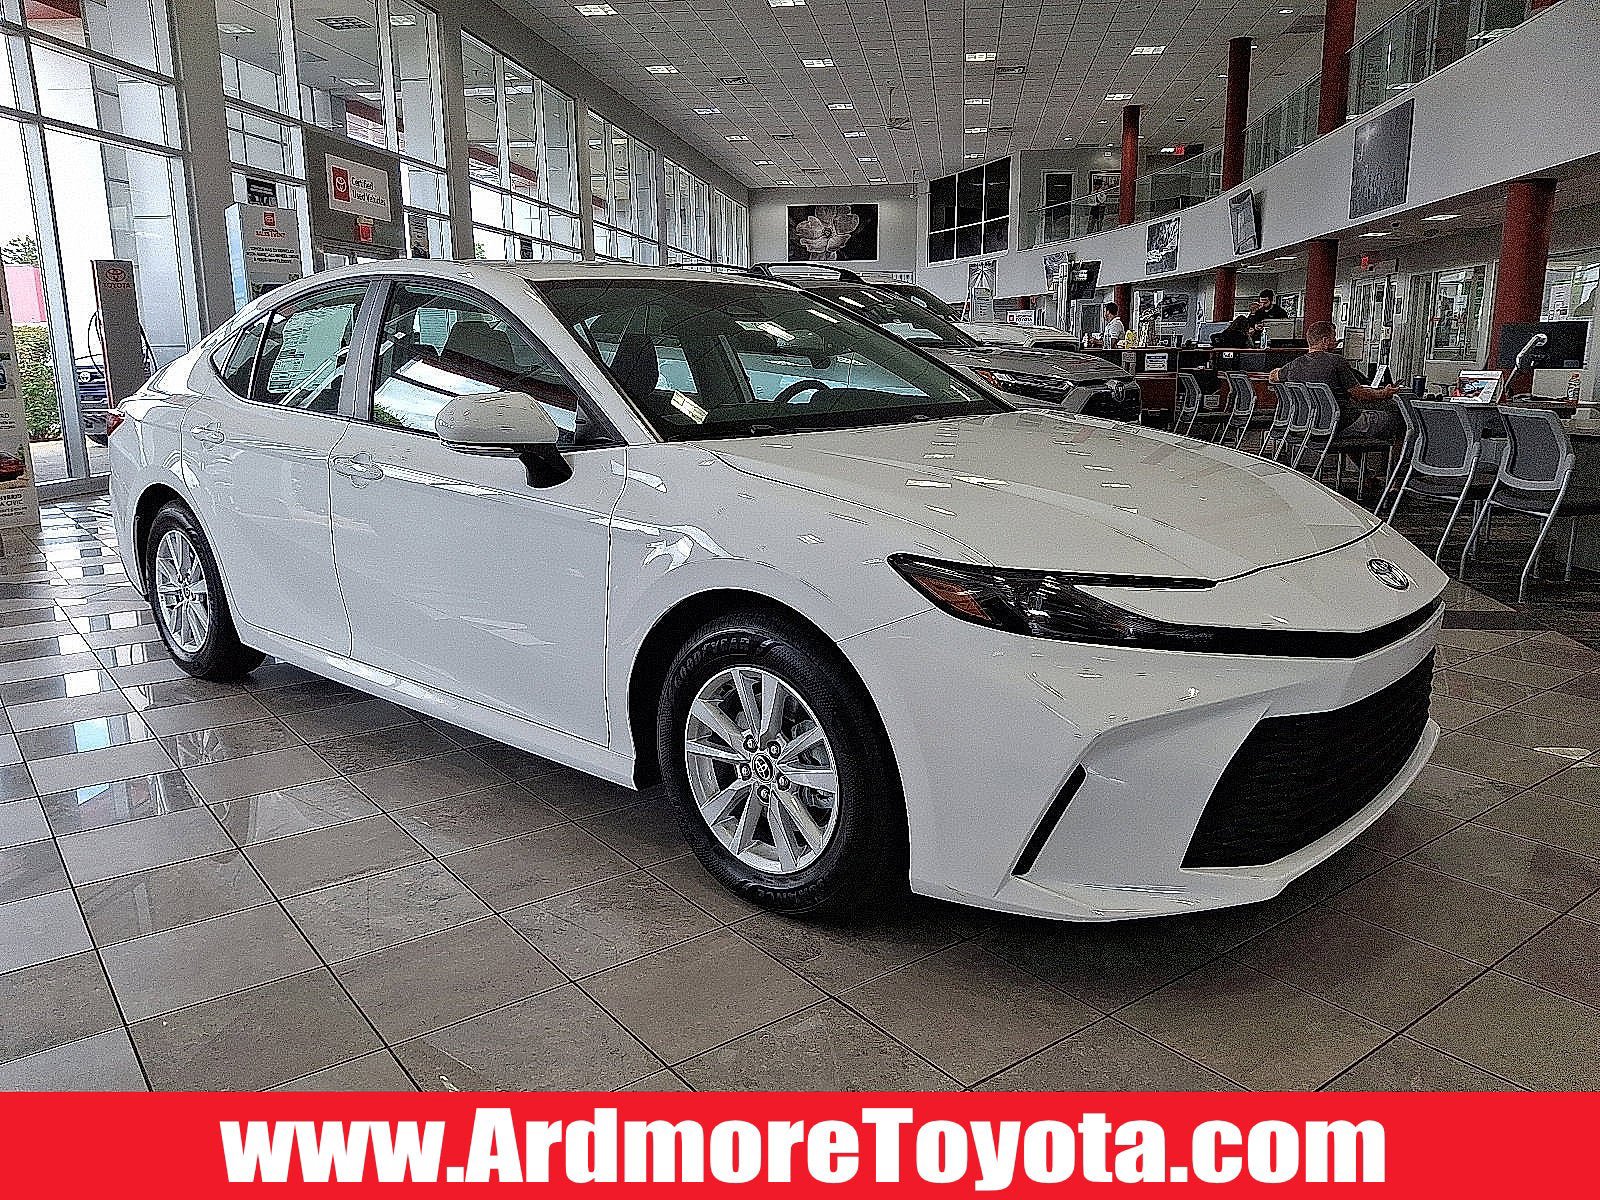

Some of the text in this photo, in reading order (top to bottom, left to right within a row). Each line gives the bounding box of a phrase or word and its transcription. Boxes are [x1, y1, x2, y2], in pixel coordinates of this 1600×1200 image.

[351, 176, 375, 191] Certified
[352, 189, 386, 207] Used Vehicles
